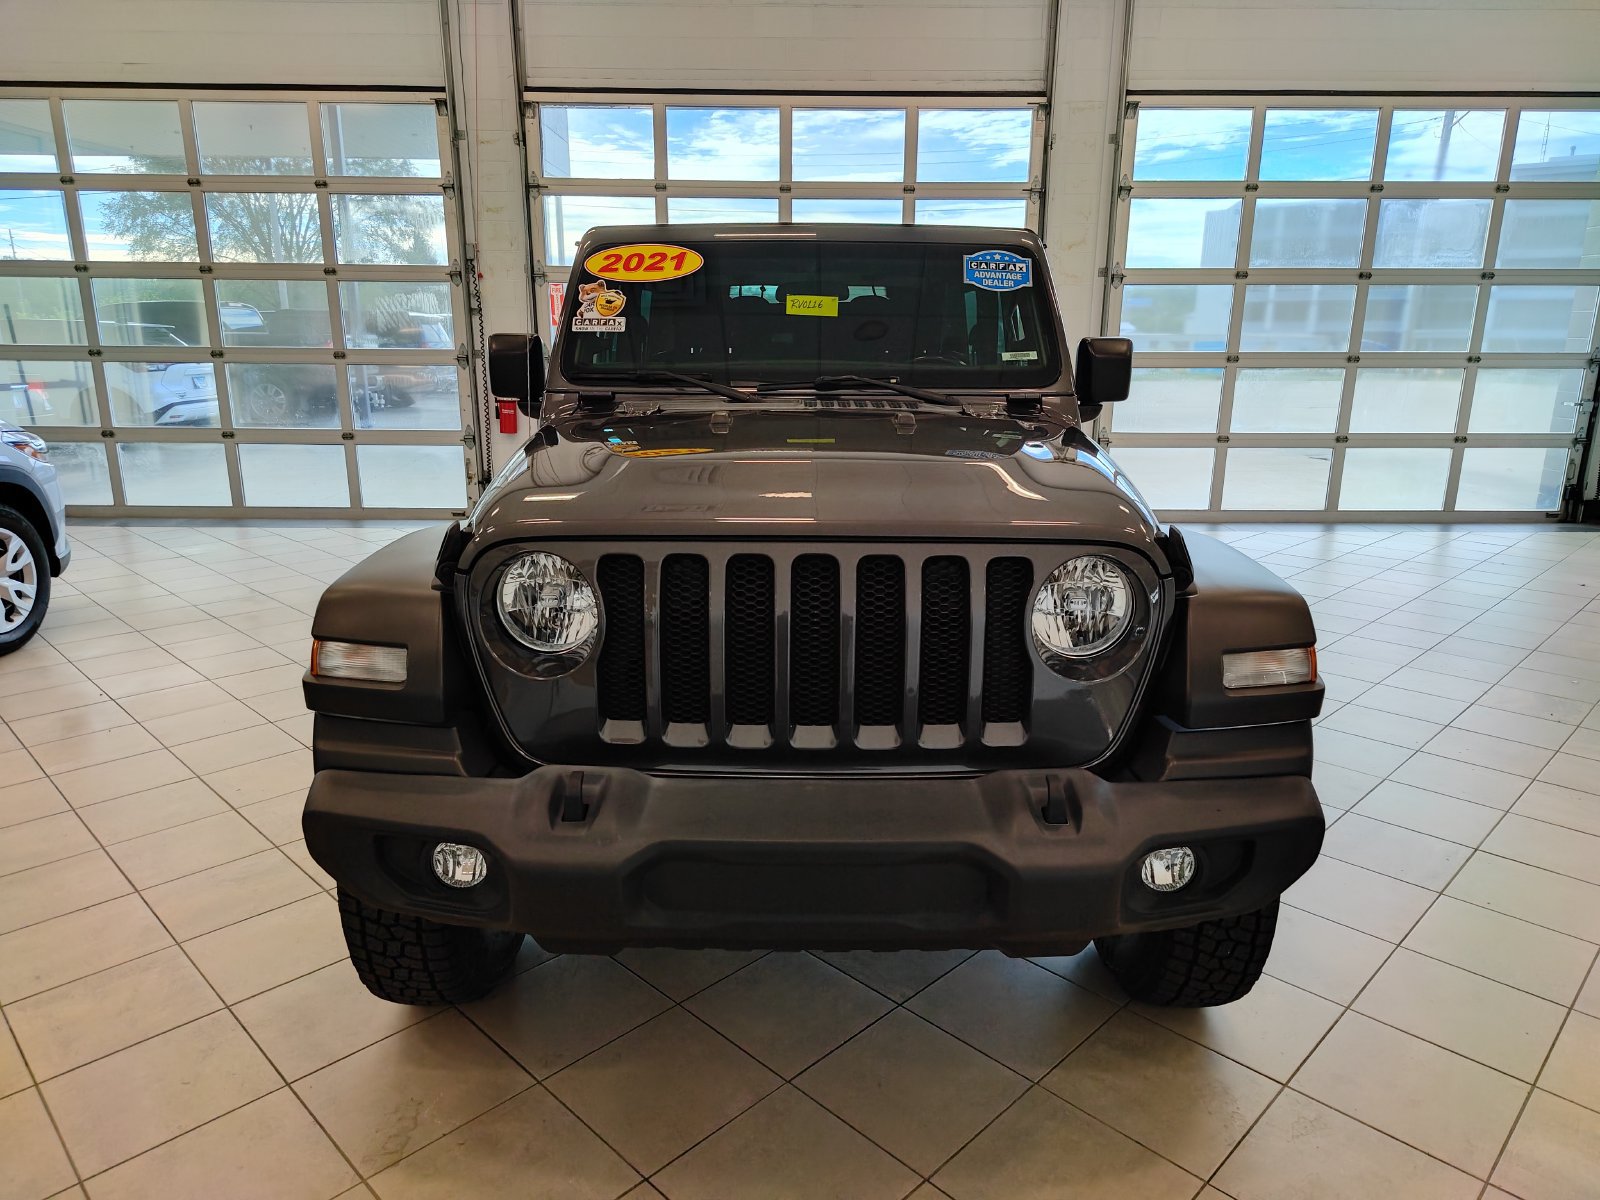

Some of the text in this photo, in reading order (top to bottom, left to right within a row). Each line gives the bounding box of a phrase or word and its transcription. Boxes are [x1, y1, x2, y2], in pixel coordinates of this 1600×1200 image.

[597, 251, 687, 273] 2021
[970, 262, 1024, 272] CARFAX
[974, 271, 1022, 280] ADVANTAGE
[982, 279, 1015, 287] DEALER
[575, 318, 622, 326] CARFAX
